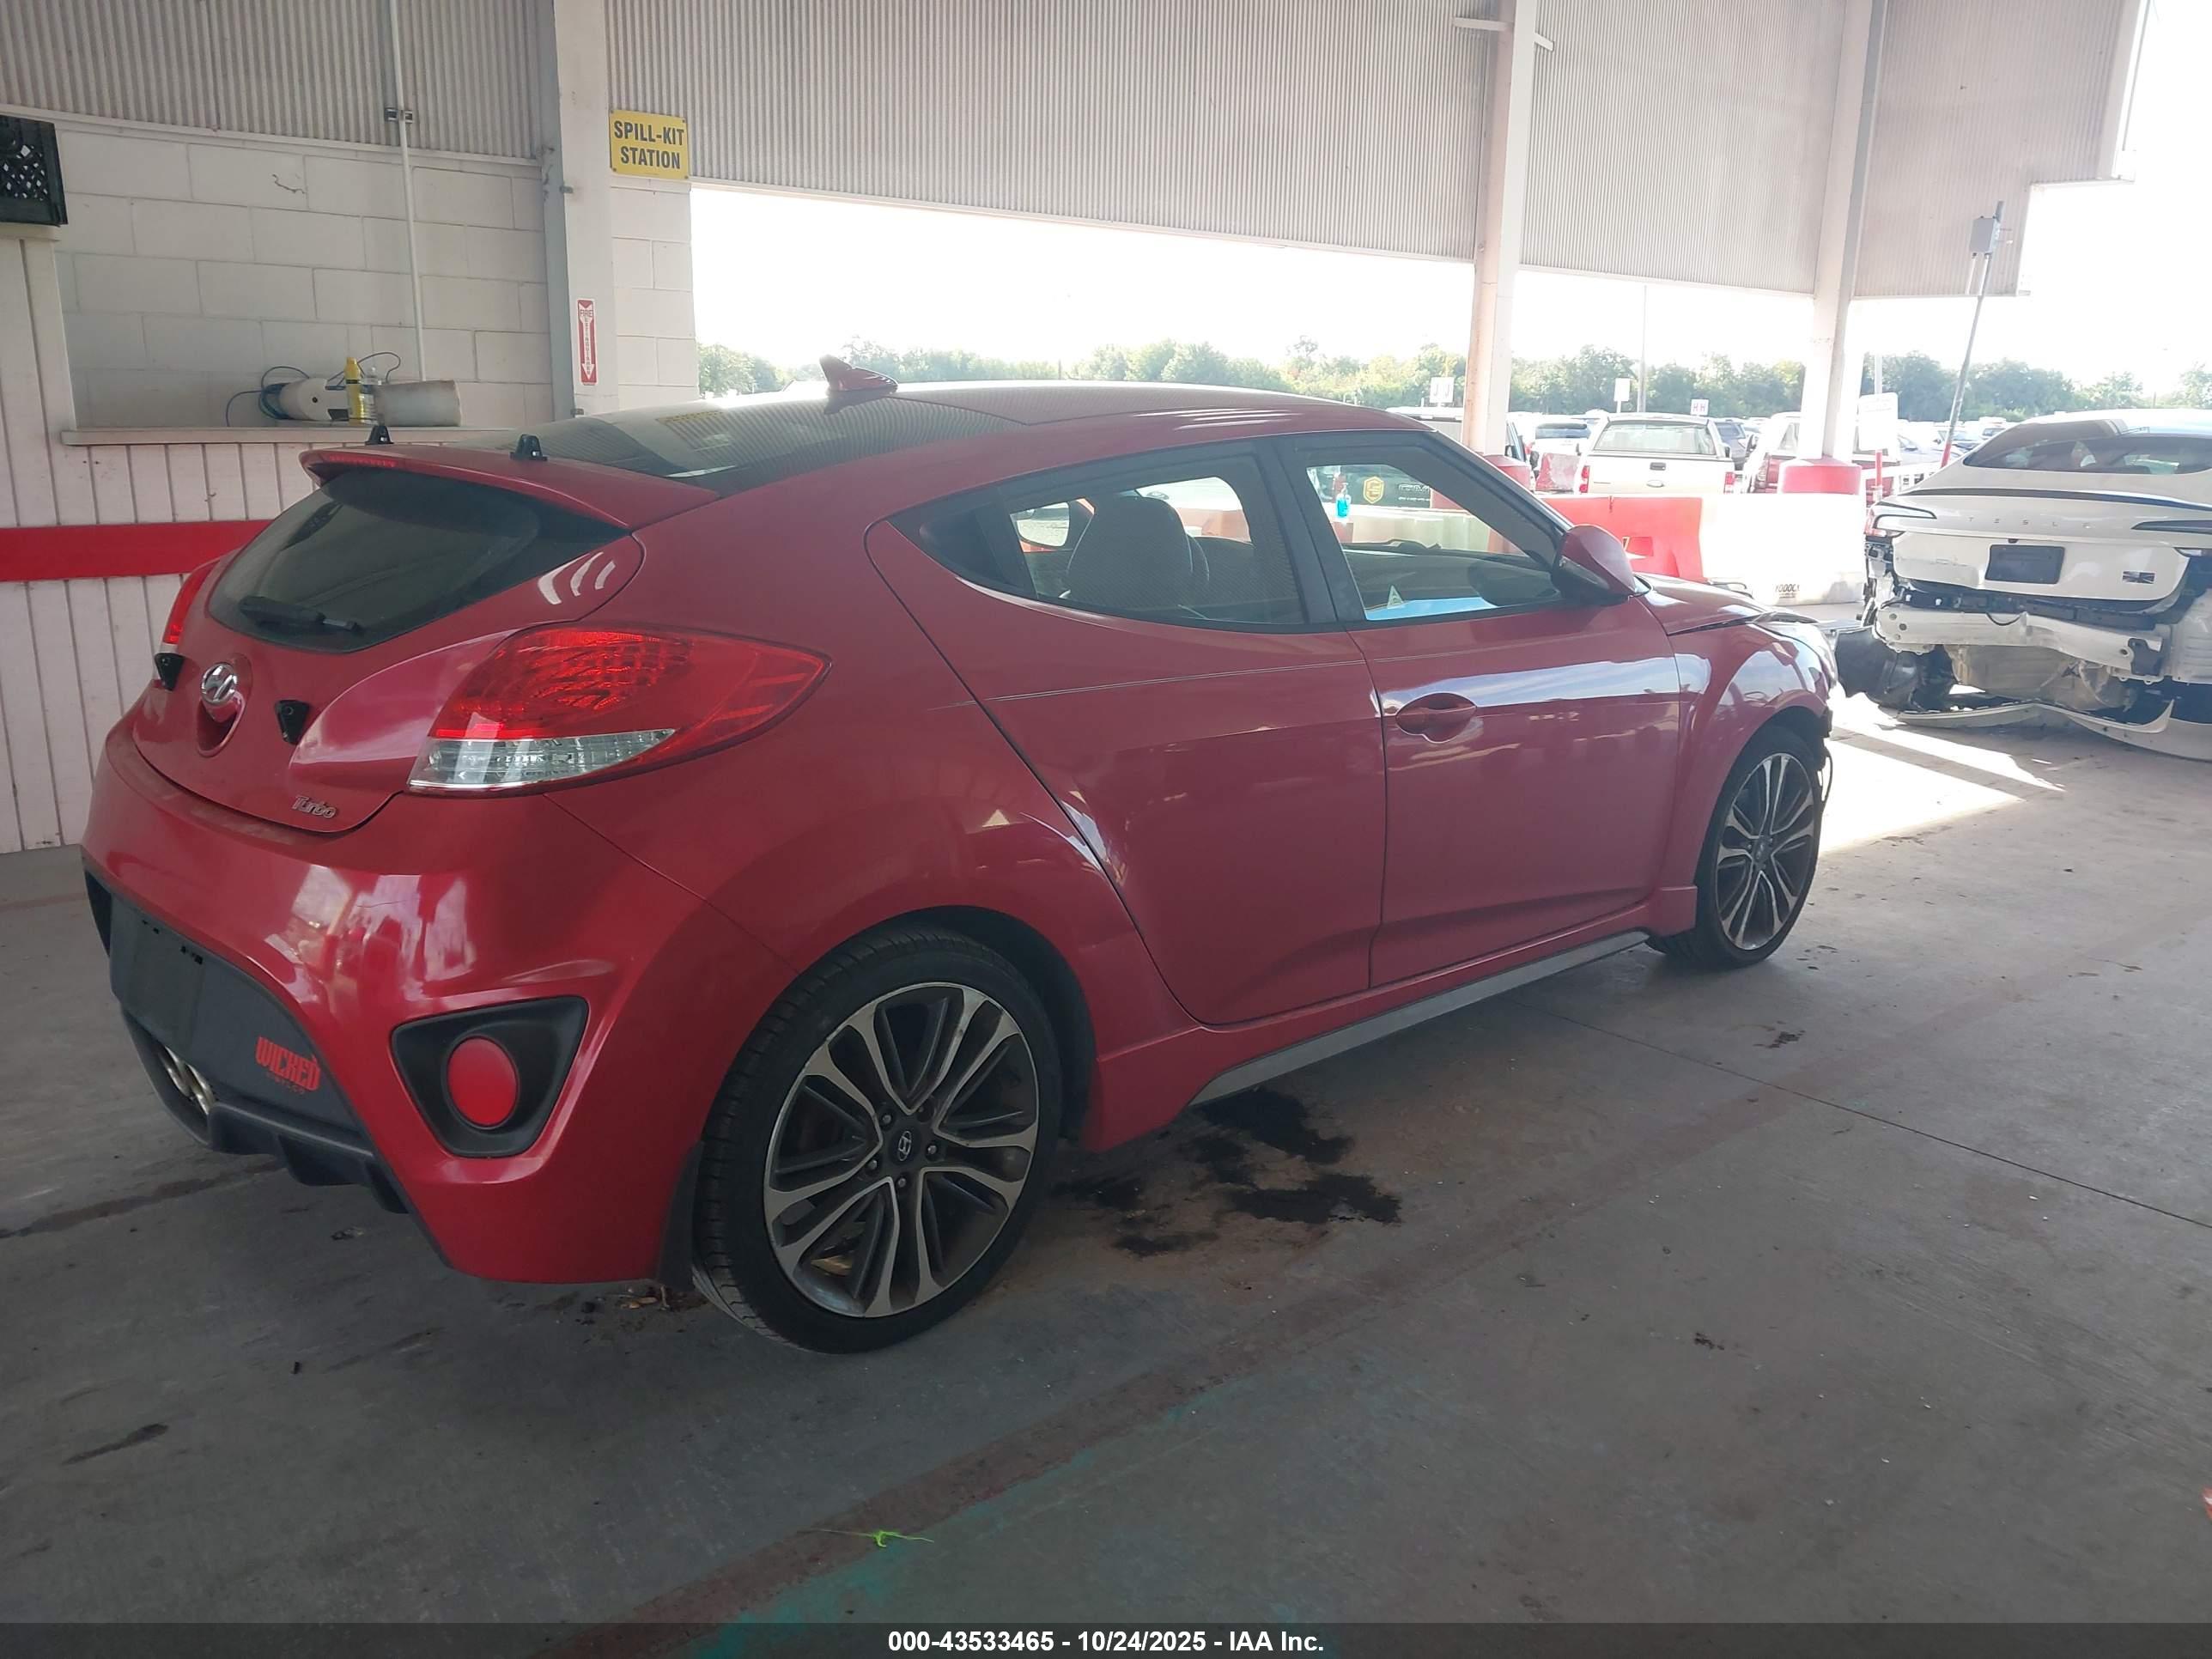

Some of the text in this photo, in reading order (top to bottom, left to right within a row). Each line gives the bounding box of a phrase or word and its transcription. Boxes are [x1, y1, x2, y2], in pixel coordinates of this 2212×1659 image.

[614, 120, 684, 146] SPILL-KIT
[620, 145, 681, 170] STATION
[292, 795, 337, 818] Turbo
[255, 1036, 321, 1091] WICKED
